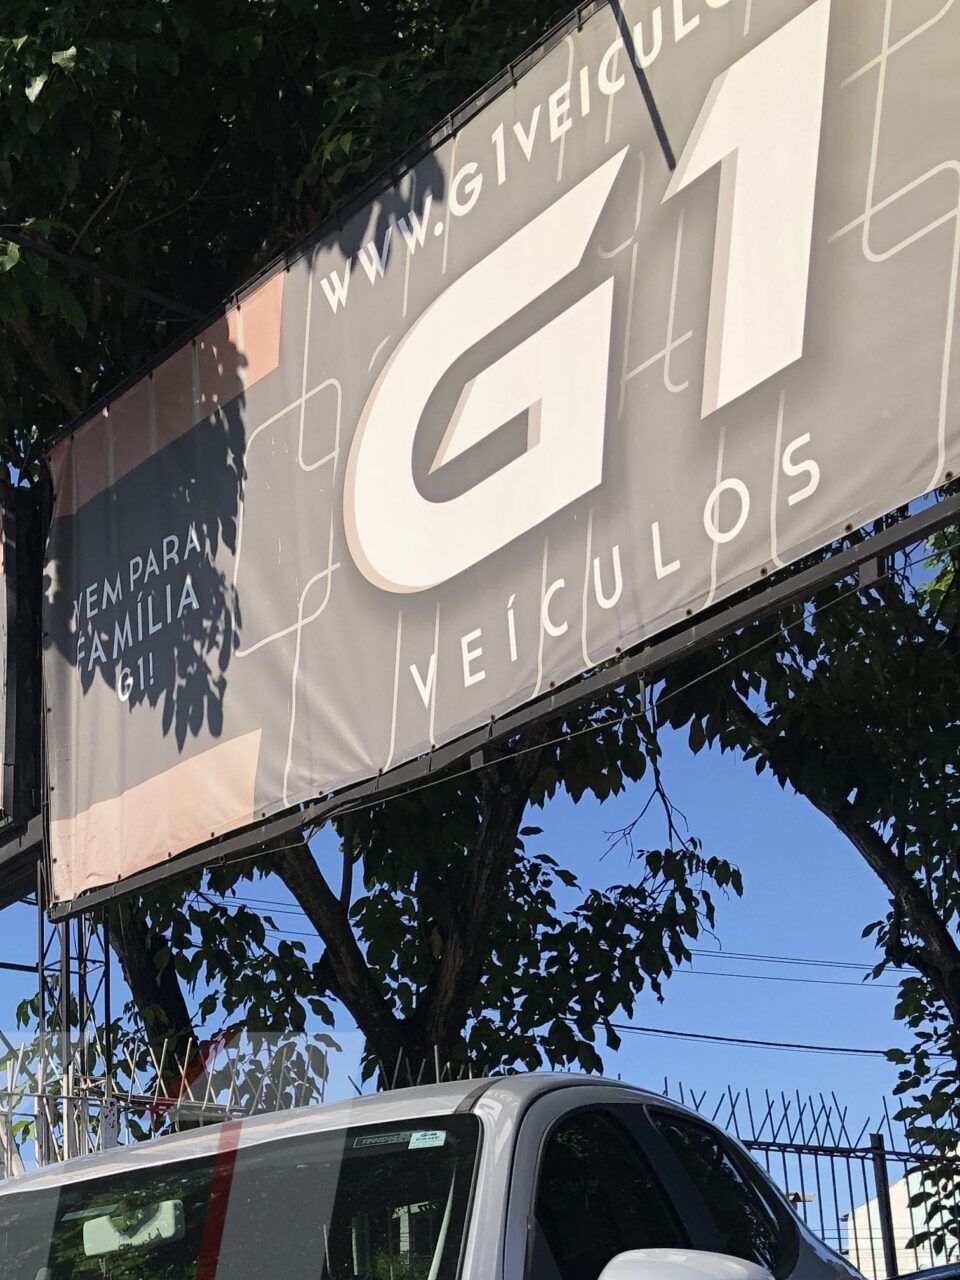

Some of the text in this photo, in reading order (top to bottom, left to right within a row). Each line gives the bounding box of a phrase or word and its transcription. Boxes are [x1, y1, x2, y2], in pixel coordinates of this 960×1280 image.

[320, 0, 731, 314] WWW.G1VEICUL
[343, 0, 832, 594] G1
[76, 573, 200, 672] FAMÍLIA
[129, 521, 201, 592] PARA
[410, 433, 820, 709] VEÍCULOS
[117, 652, 154, 702] G1!
